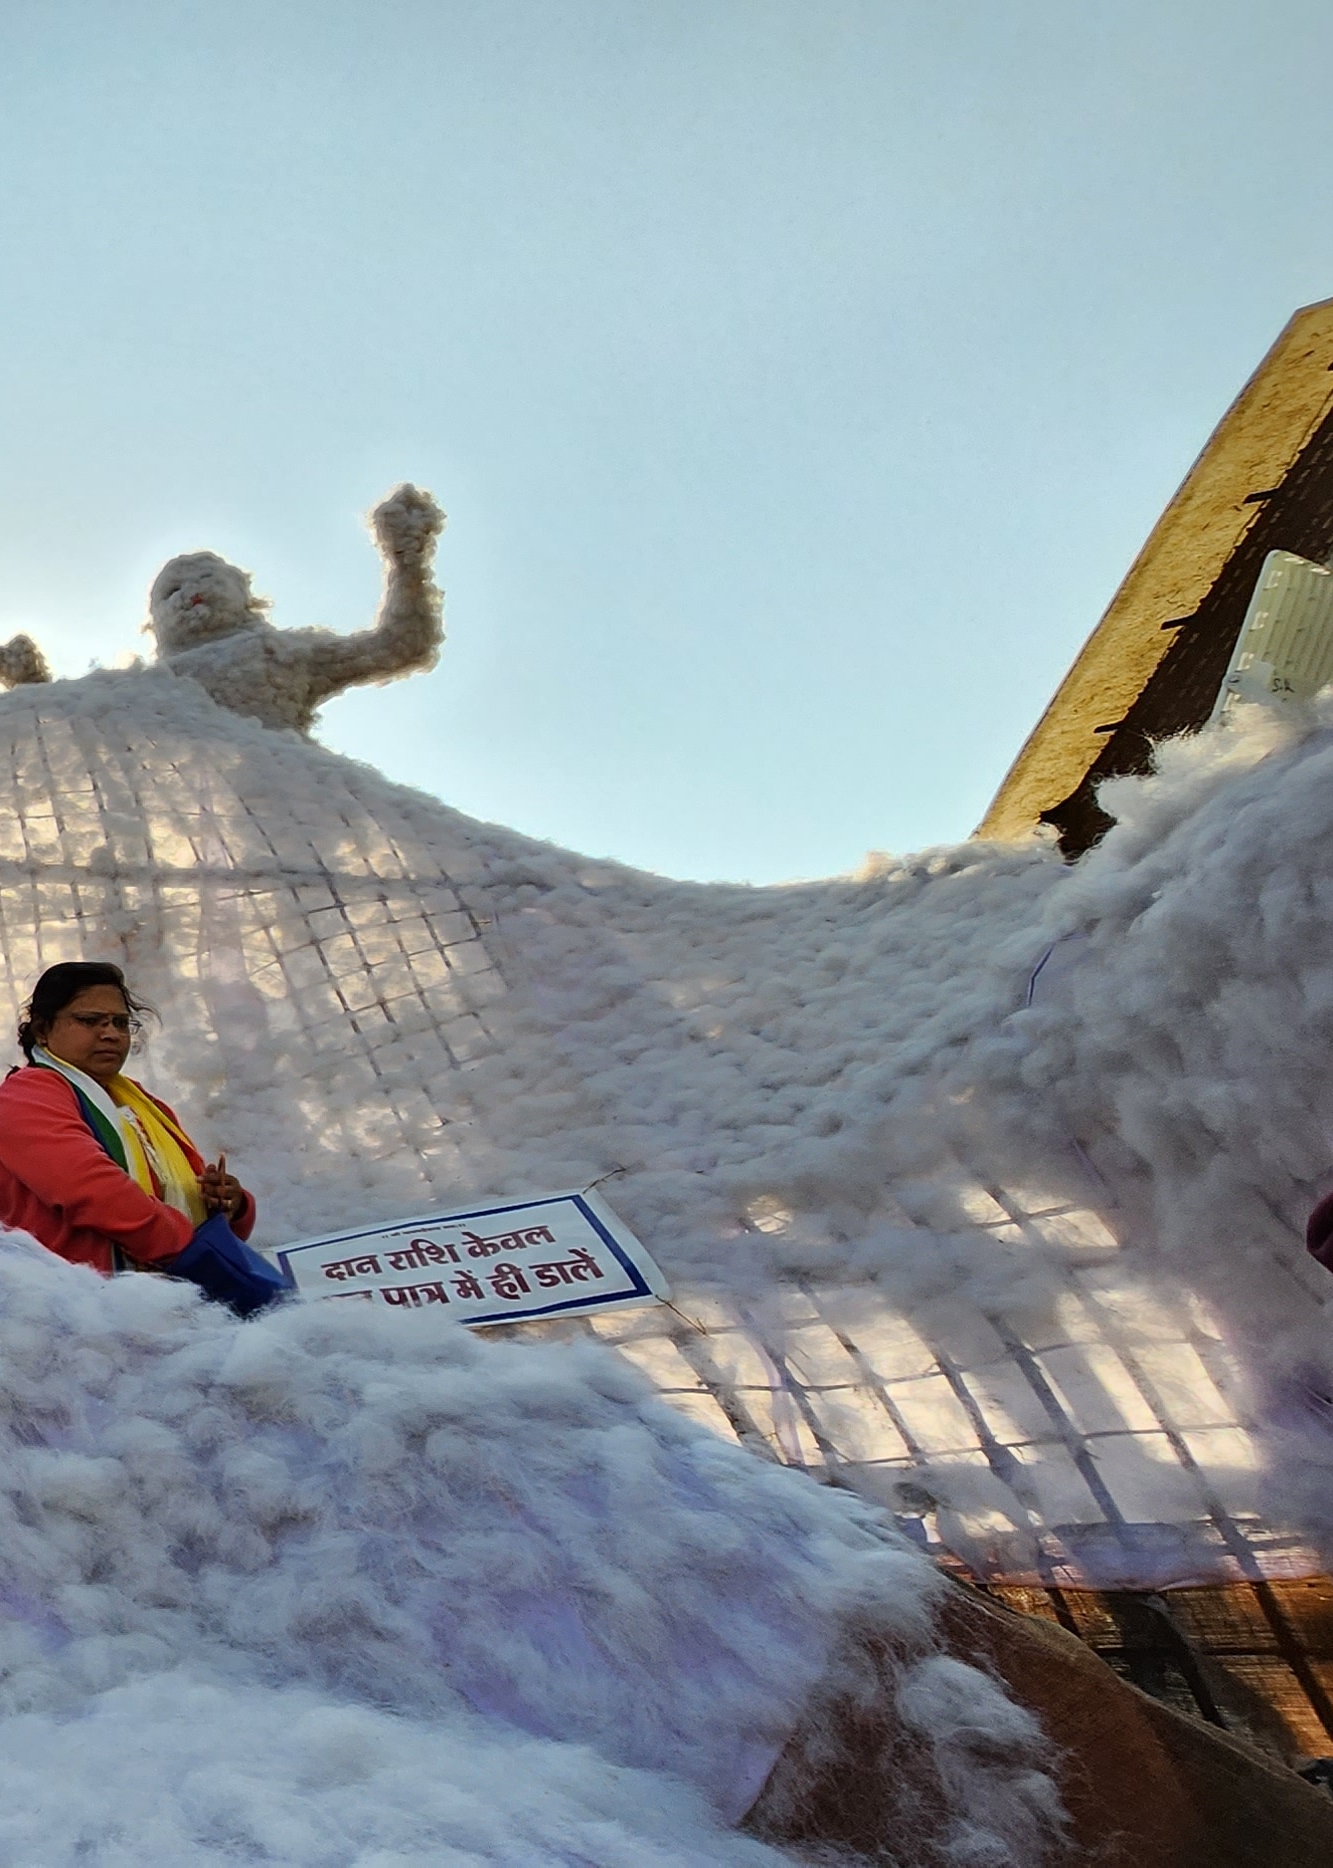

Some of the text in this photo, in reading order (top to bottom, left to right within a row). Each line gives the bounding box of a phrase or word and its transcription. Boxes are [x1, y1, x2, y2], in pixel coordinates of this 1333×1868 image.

[321, 1255, 382, 1281] दान
[384, 1238, 462, 1271] राशि
[461, 1225, 556, 1258] केवल
[380, 1248, 605, 1309] पात्र में ही डालें
